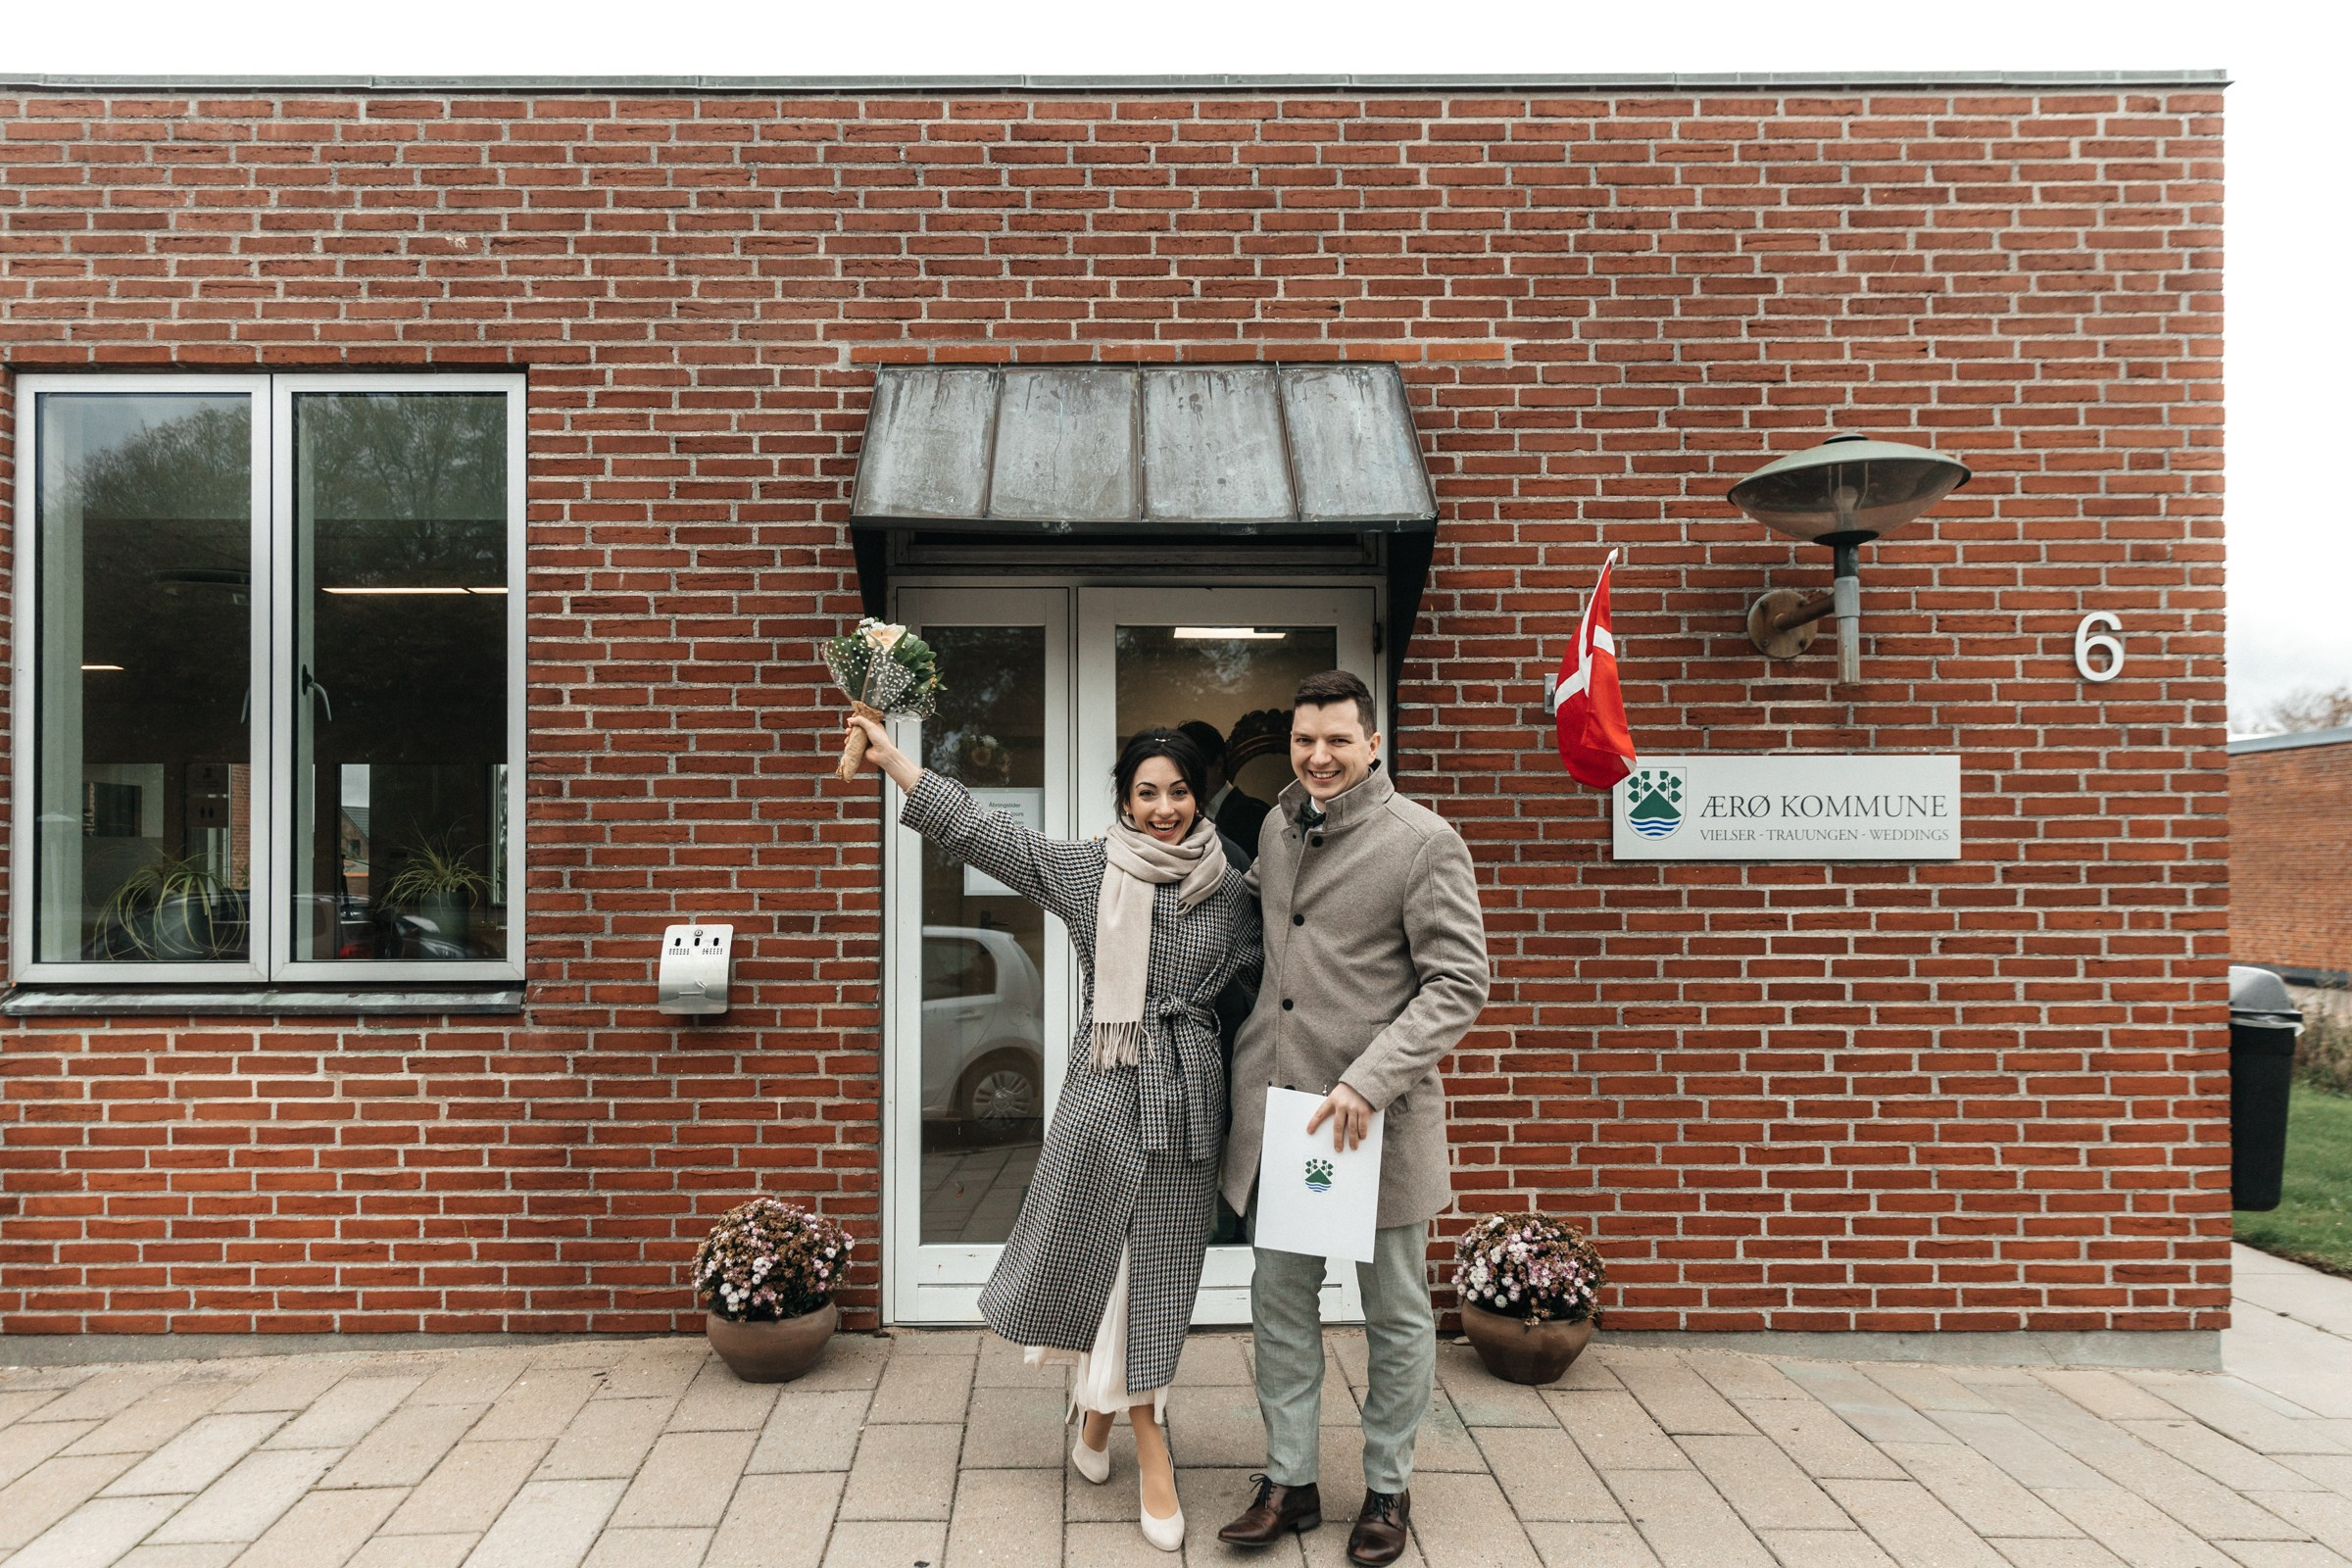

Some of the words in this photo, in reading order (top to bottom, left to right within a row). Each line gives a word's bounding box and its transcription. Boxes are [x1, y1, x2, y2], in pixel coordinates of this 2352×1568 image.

[2075, 611, 2125, 682] 6
[1699, 795, 1771, 818] ÆRØ
[1780, 795, 1948, 817] KOMMUNE
[1699, 829, 1756, 841] VIELSER
[1766, 829, 1858, 841] TRAUUNGEN
[1869, 829, 1949, 841] WEDDINGS
